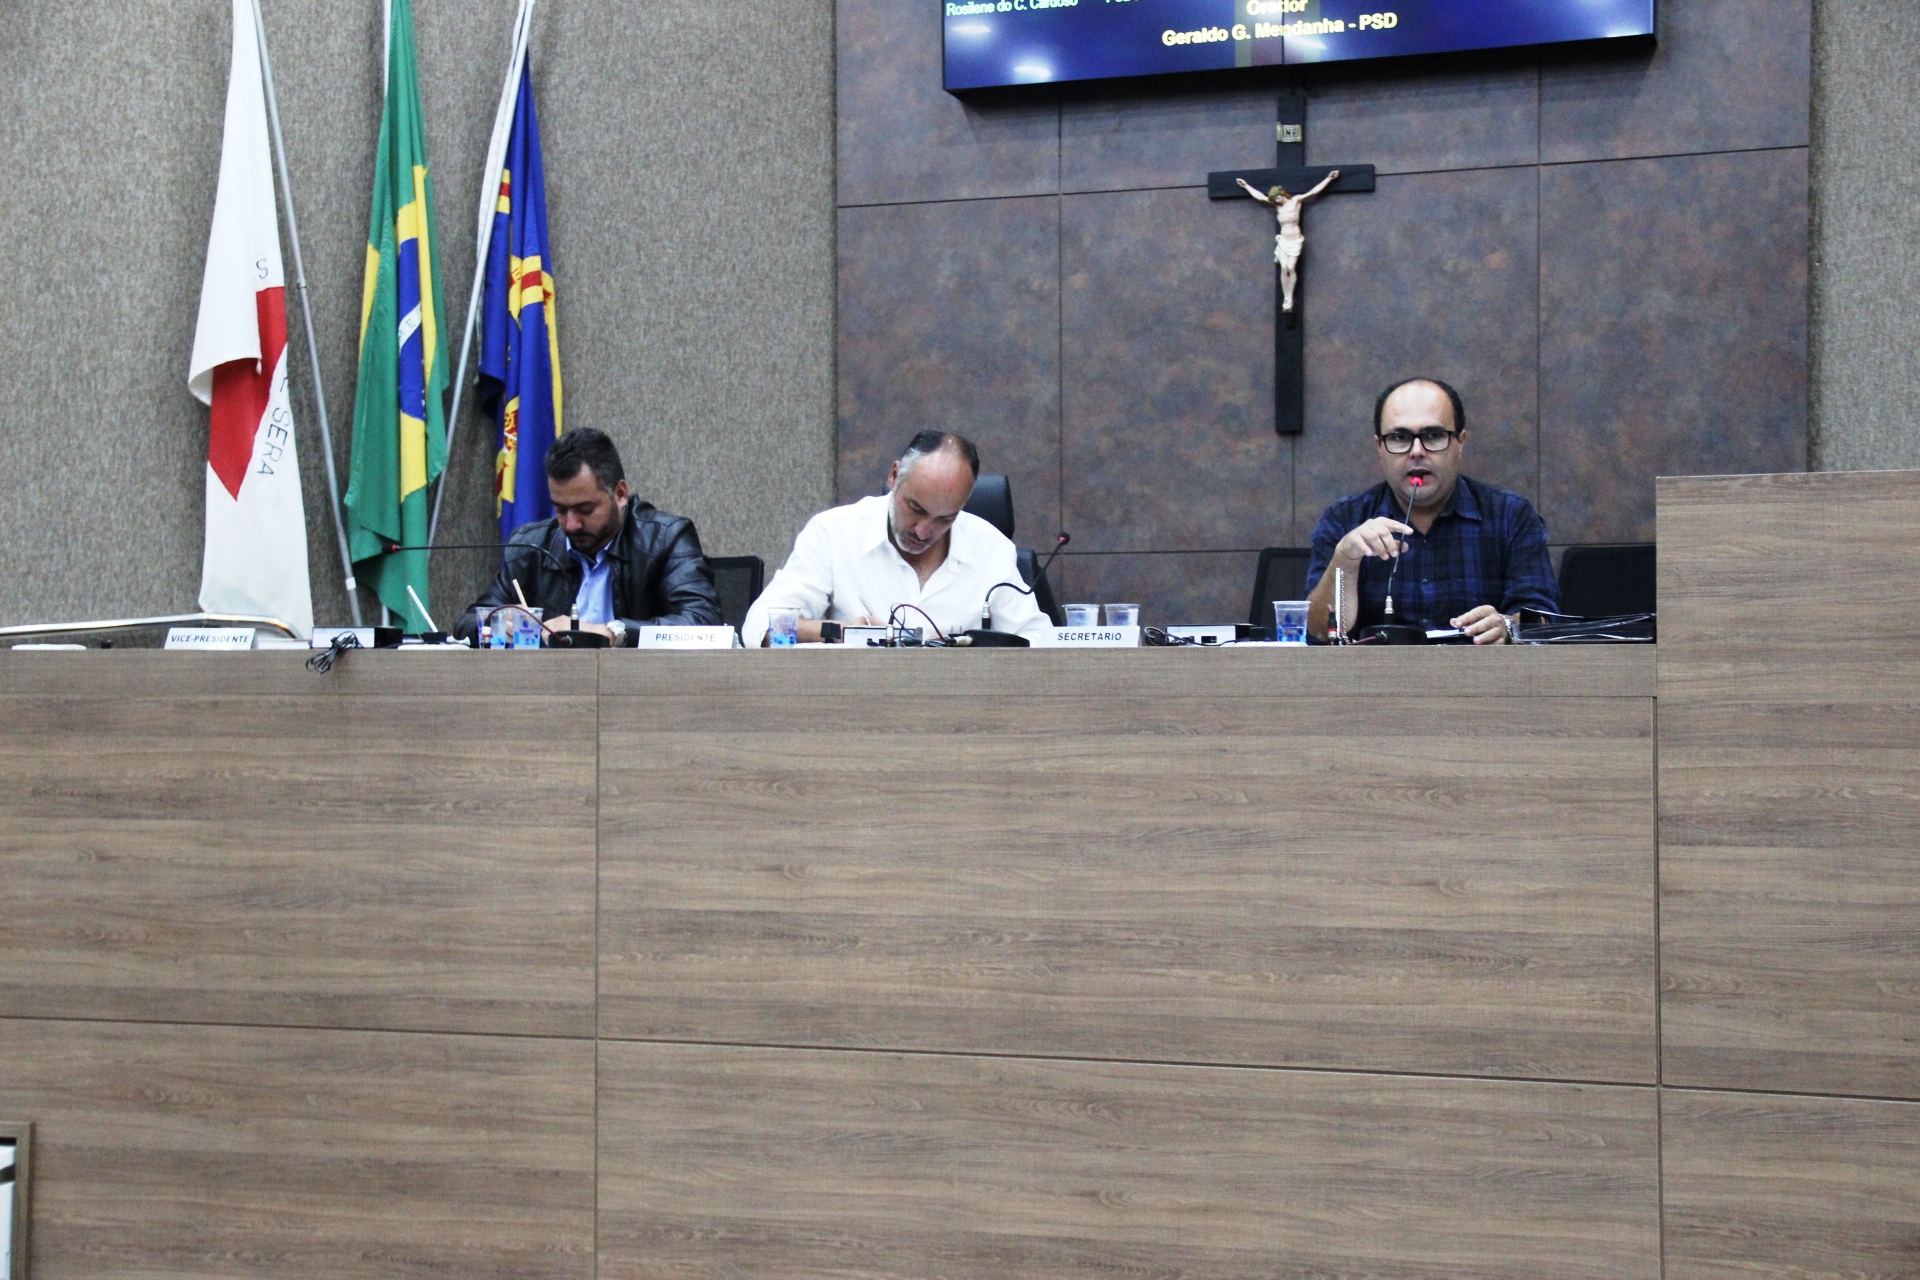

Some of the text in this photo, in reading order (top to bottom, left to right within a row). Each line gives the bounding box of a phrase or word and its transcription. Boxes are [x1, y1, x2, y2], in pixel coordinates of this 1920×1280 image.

[946, 1, 995, 16] Rosilene
[1246, 0, 1308, 15] Orador
[1161, 26, 1229, 46] Geraldo
[1231, 24, 1251, 41] G.
[1255, 18, 1345, 39] Mendanha
[1359, 12, 1398, 31] PSD
[257, 407, 291, 475] SERA
[171, 634, 250, 643] VICE-PRESIDENTE
[655, 633, 716, 642] PRESIDENTE
